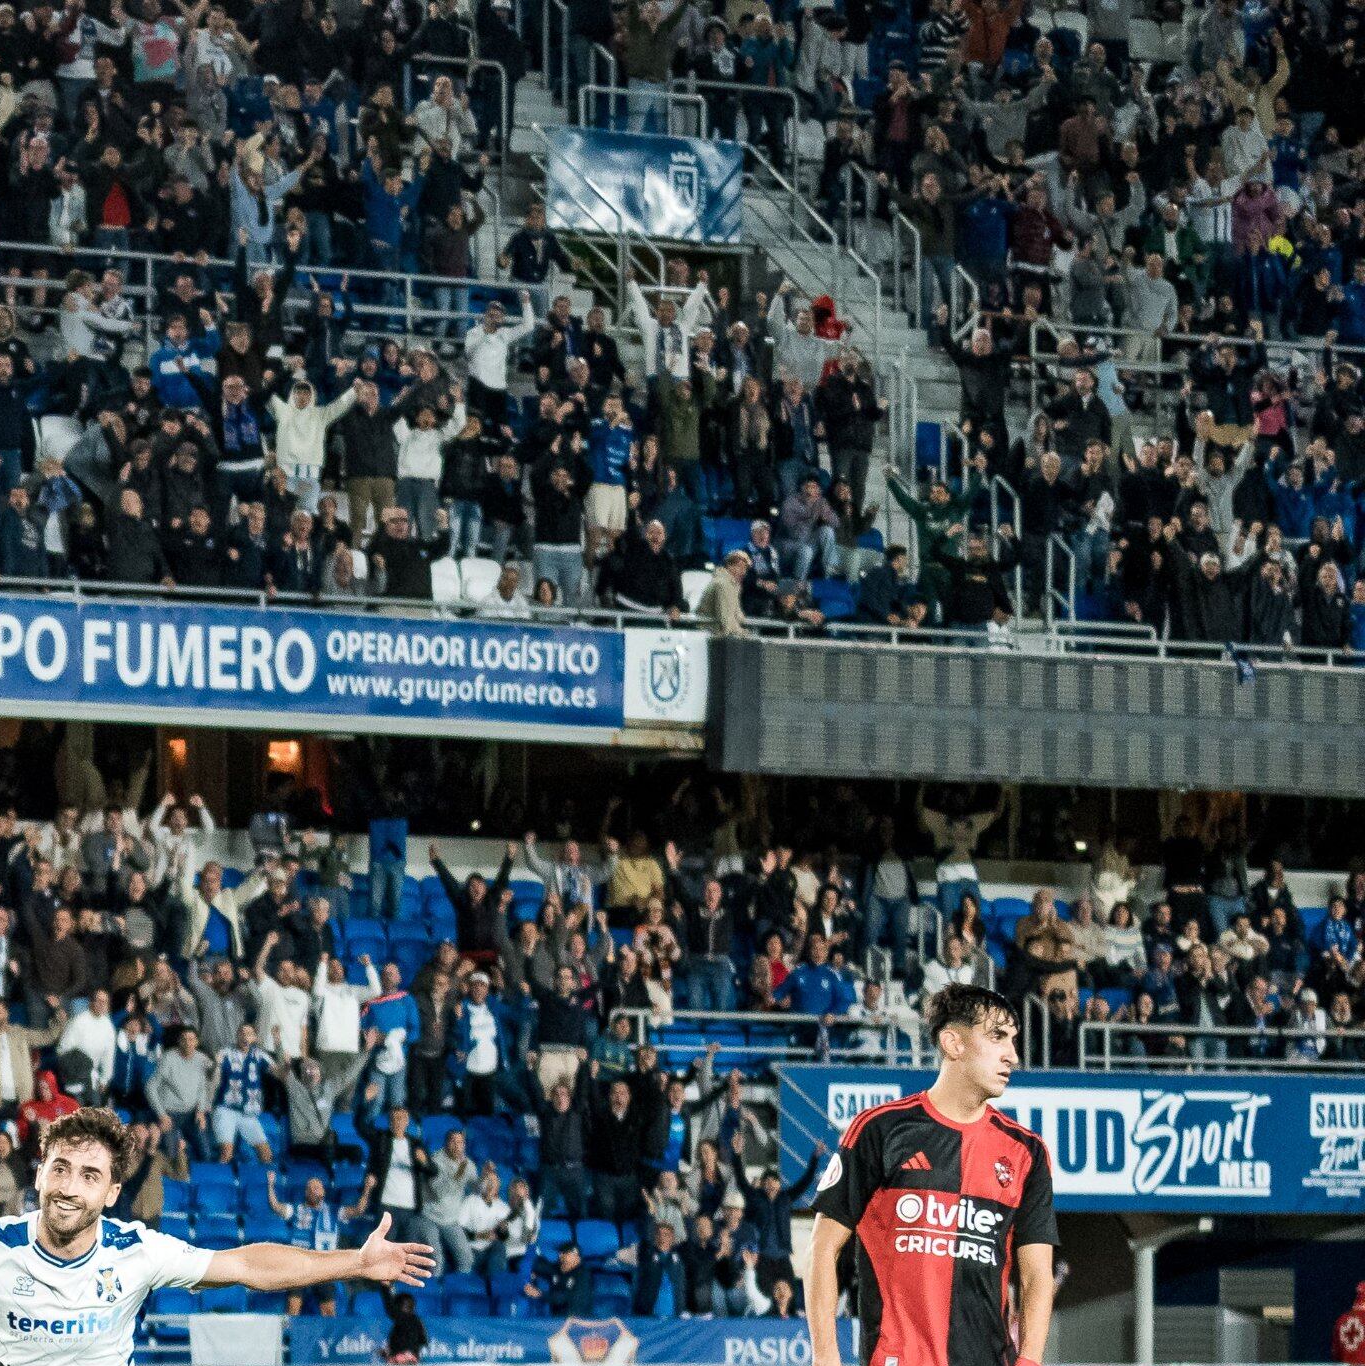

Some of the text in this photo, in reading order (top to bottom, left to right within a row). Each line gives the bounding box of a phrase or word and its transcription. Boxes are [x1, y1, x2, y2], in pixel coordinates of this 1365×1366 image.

[82, 619, 317, 694] FUMERO
[326, 630, 466, 668] OPERADOR
[469, 634, 600, 676] LOGÍSTICO
[326, 674, 598, 708] www.grupofumero.es
[1133, 1092, 1272, 1195] Sport
[1218, 1160, 1272, 1188] MED
